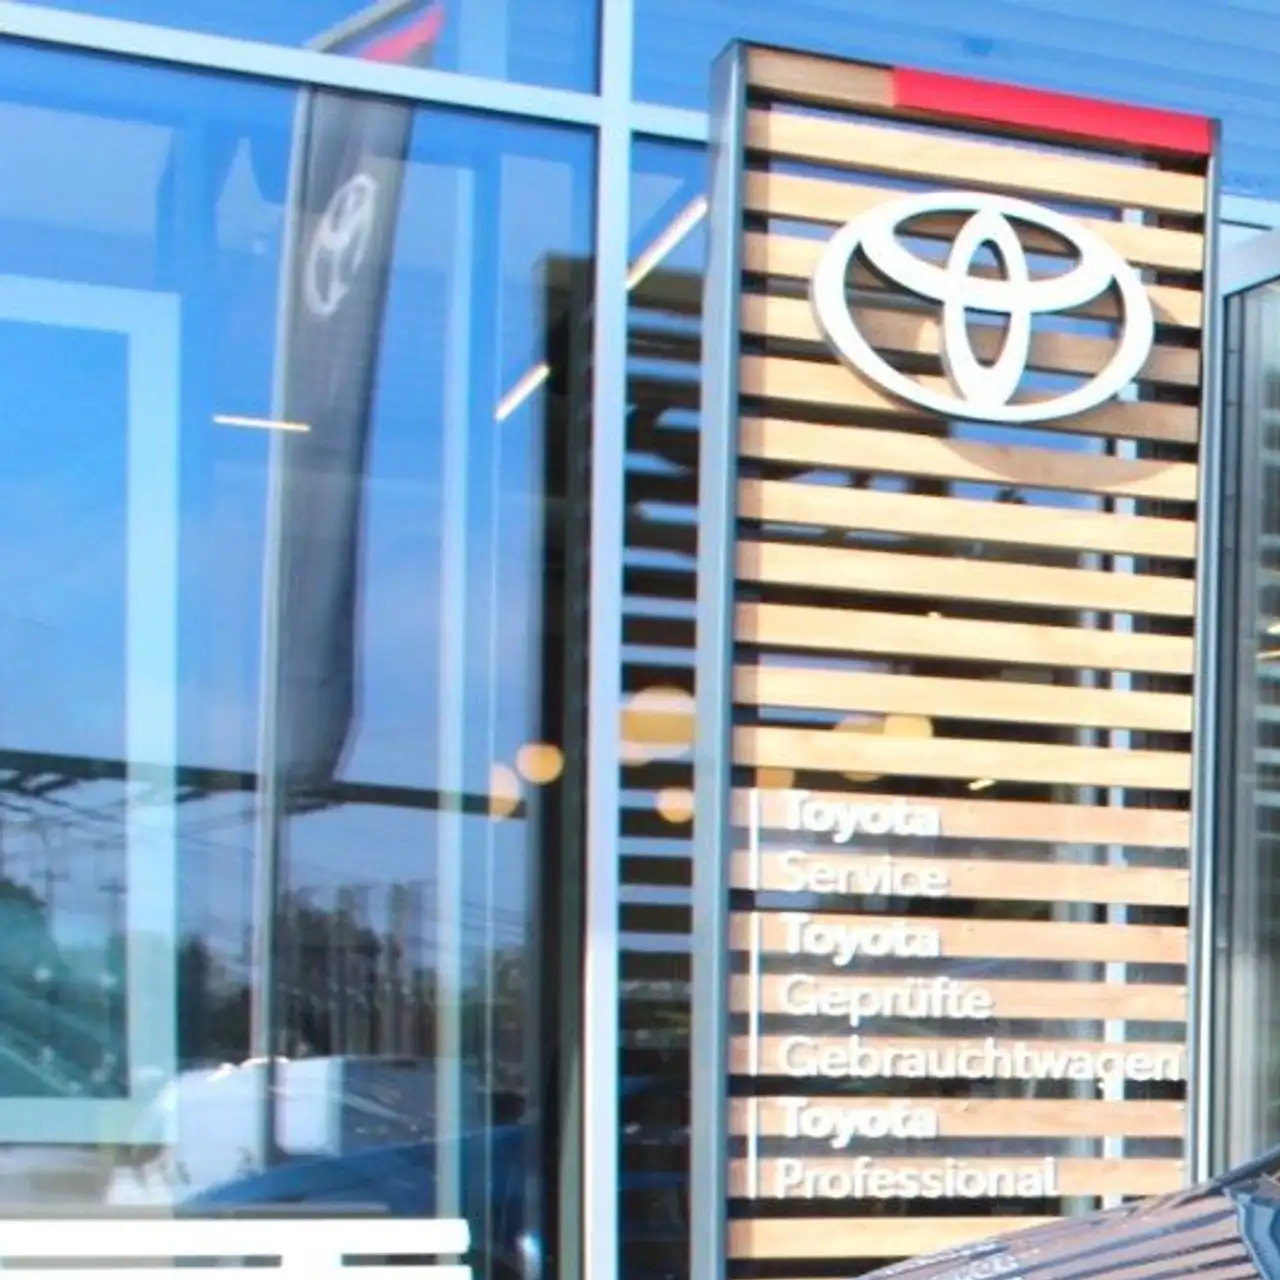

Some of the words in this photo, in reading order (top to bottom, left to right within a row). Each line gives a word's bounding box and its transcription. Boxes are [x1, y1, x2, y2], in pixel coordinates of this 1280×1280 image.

[781, 791, 939, 843] Toyota
[778, 851, 950, 896] Service
[778, 911, 939, 965] Toyota
[774, 974, 994, 1027] Geprüfte
[775, 1034, 1183, 1090] Gebrauchtwagen
[776, 1097, 938, 1149] Toyota
[775, 1156, 1057, 1199] Professional
